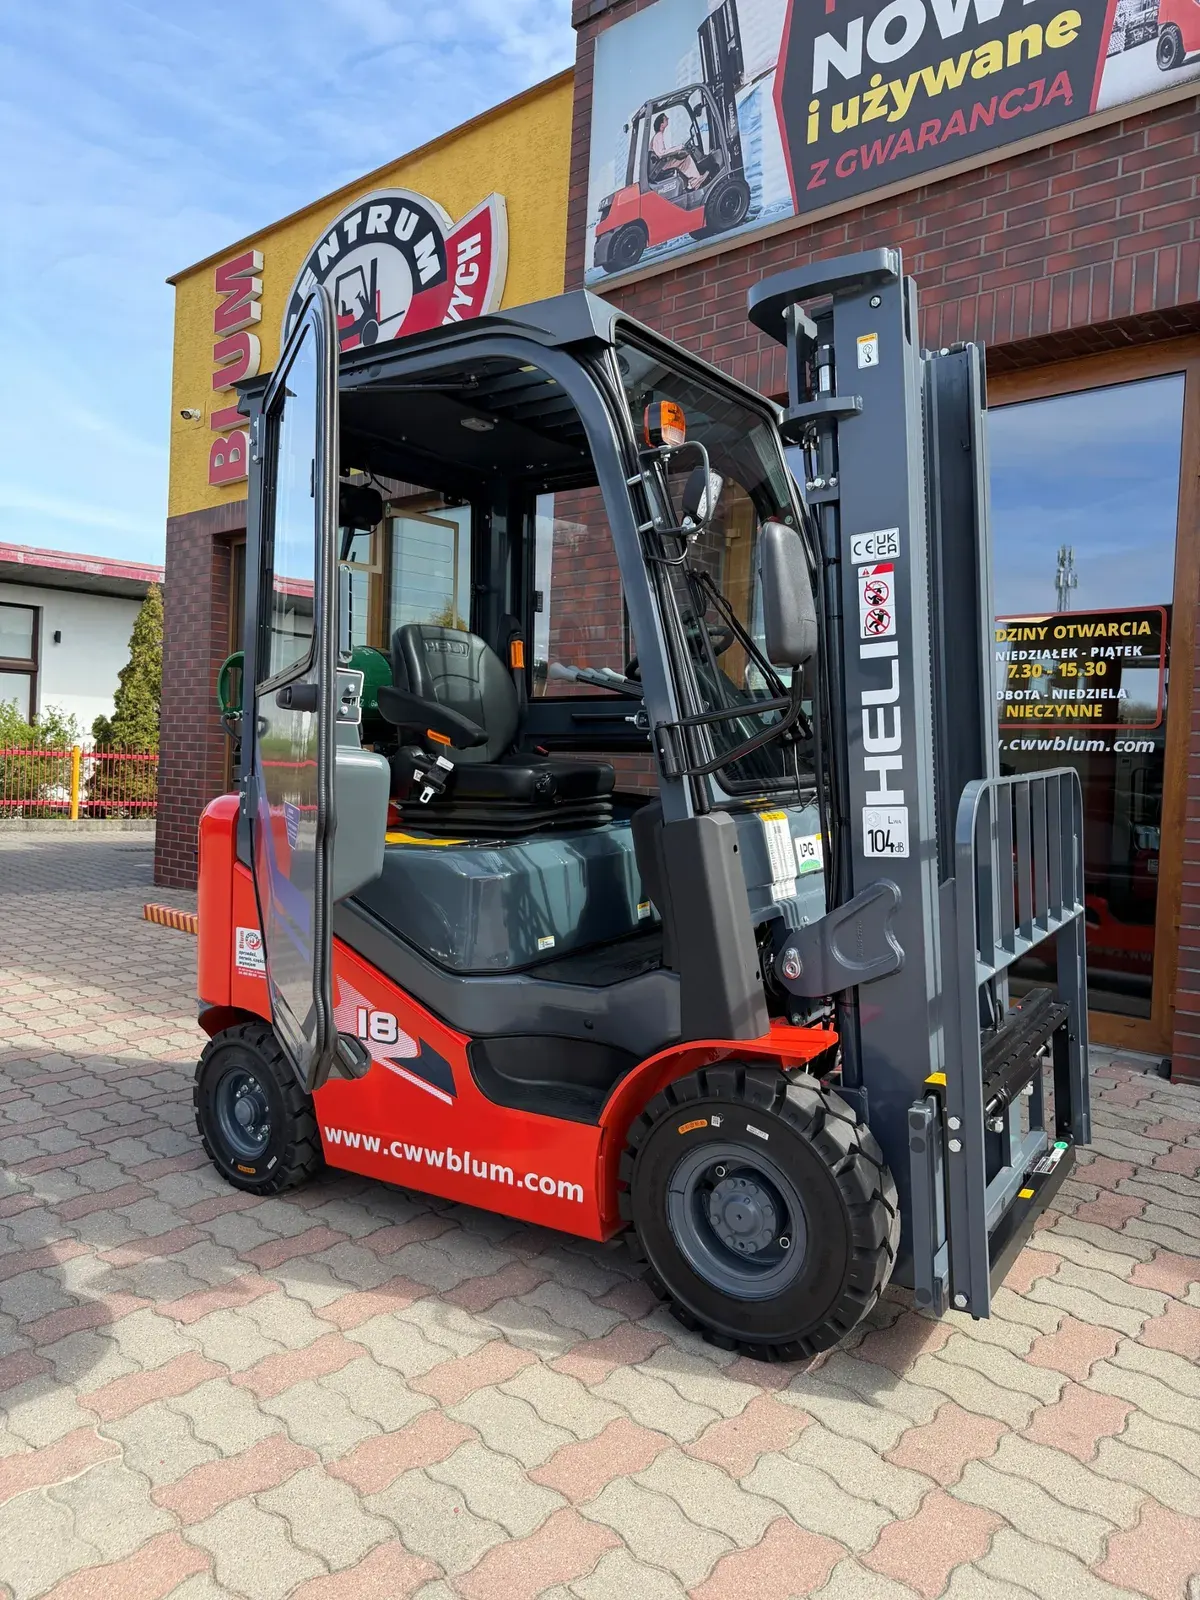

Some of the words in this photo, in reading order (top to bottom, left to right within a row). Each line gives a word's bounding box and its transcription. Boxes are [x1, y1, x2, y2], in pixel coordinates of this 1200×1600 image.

[812, 0, 1038, 95] NOW
[806, 99, 820, 145] i
[831, 9, 1083, 135] używane
[806, 158, 830, 191] Z
[835, 70, 1075, 179] GWARANCJĄ
[1053, 621, 1151, 639] OTWARCIA
[1090, 645, 1143, 660] PIĄTEK
[1008, 663, 1042, 679] 7.30
[1059, 661, 1107, 678] 15.30
[1052, 688, 1128, 700] NIEDZIELA
[860, 640, 905, 806] HELI
[1006, 704, 1103, 718] NIECZYNNE
[799, 842, 815, 857] LPG
[357, 1005, 399, 1044] 18
[324, 1126, 584, 1203] www.cwwblum.com
